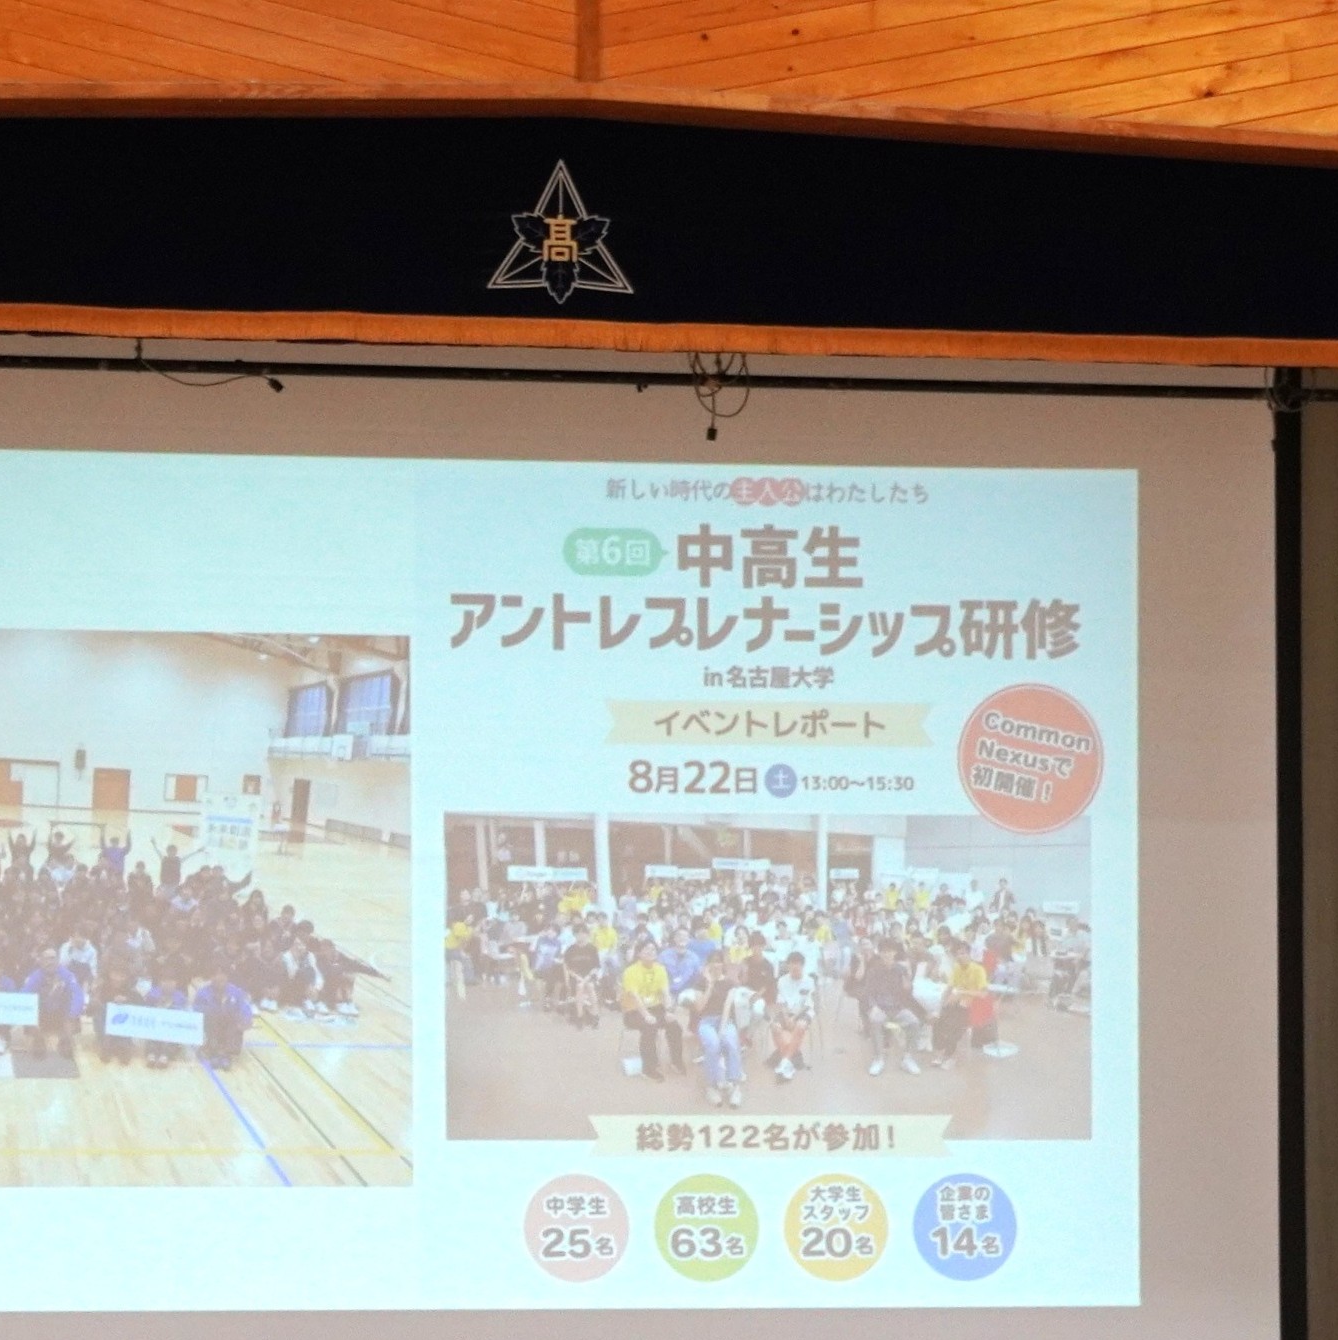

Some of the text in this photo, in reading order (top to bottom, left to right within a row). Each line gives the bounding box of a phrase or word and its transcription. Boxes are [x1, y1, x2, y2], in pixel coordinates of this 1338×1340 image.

[542, 214, 578, 262] 高
[606, 476, 930, 504] 新しい時代の主人公はわたしたち
[574, 523, 864, 589] 第6回 中高生
[450, 592, 1082, 660] アントレプレナーシップ研修
[654, 708, 886, 738] イベントレポート
[984, 711, 1091, 752] Common
[977, 738, 1073, 778] Nexusで
[546, 1195, 607, 1216] 中学生
[676, 1195, 737, 1216] 高校生
[810, 1185, 862, 1203] 大学生
[939, 1185, 991, 1203] 企業の
[803, 1204, 870, 1221] スタッフ
[939, 1203, 990, 1221] 皆さま
[541, 1227, 615, 1259] 25名
[670, 1226, 745, 1259] 63名
[801, 1226, 875, 1258] 20名
[931, 1225, 1001, 1257] 14名
